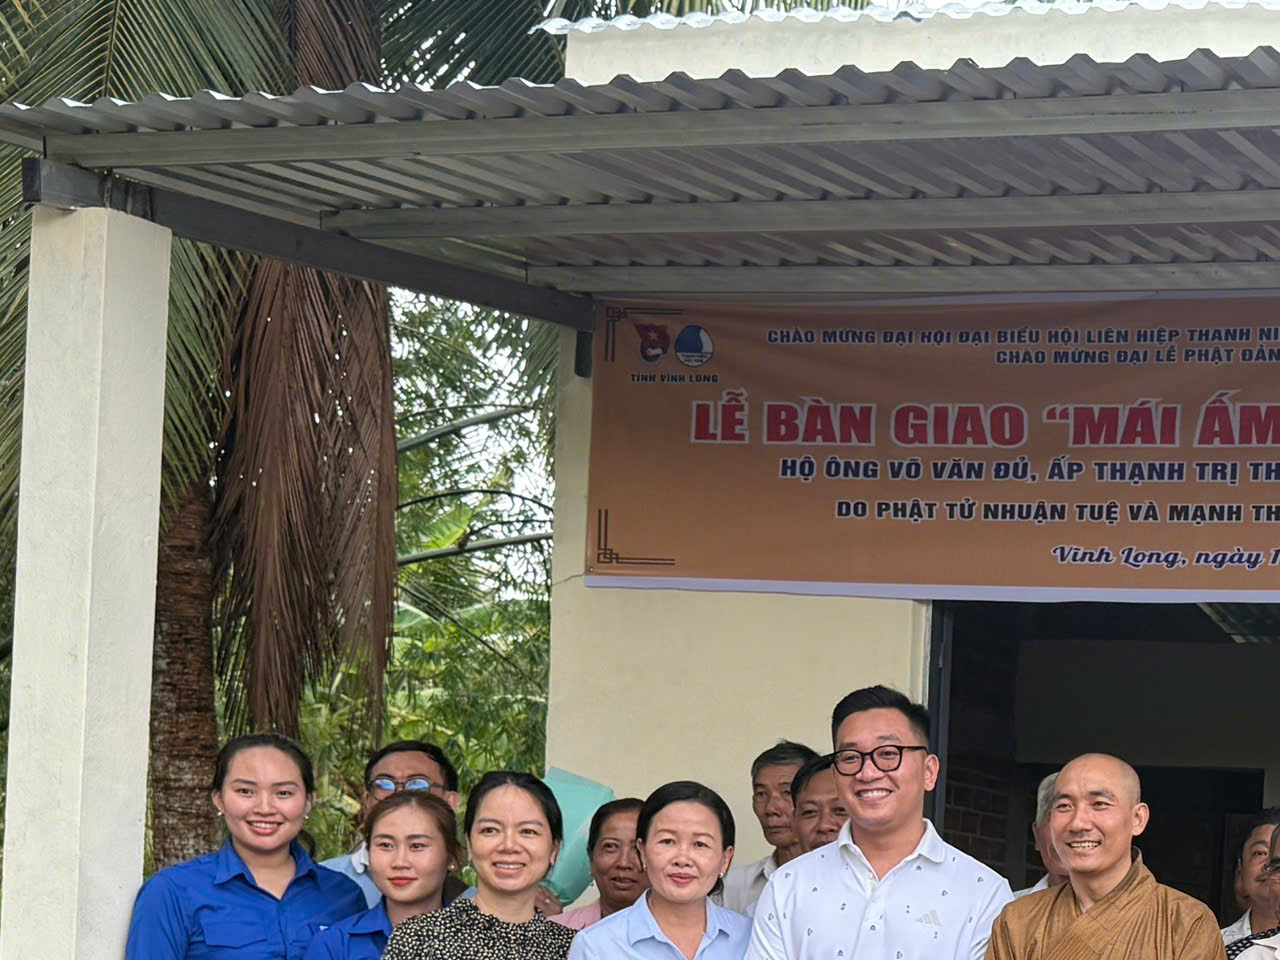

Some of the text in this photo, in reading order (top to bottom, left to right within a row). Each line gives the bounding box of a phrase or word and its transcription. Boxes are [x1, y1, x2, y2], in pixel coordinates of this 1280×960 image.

[767, 327, 815, 345] CHÀO
[882, 330, 914, 347] ĐẠI
[919, 329, 951, 347] HỘI
[957, 330, 991, 347] ĐẠI
[1047, 328, 1080, 346] HỘI
[1086, 328, 1129, 345] LIÊN
[1136, 328, 1180, 346] HIỆP
[1187, 328, 1251, 344] THANH
[995, 348, 1047, 365] CHÀO
[1053, 347, 1110, 365] MỪNG
[1116, 348, 1150, 366] ĐẠI
[1155, 344, 1178, 363] LỄ
[1183, 346, 1234, 365] PHẬT
[689, 374, 718, 382] LONG
[692, 389, 747, 442] LỄ
[765, 397, 874, 444] BÀN
[893, 405, 1025, 446] GIAO
[1044, 399, 1179, 446] “MÁI
[781, 457, 815, 481] HỘ
[825, 457, 879, 479] ÔNG
[889, 458, 922, 480] VÕ
[931, 458, 984, 480] VĂN
[993, 457, 1037, 482] ĐỦ,
[1047, 455, 1083, 480] ẤP
[1094, 462, 1184, 484] THẠNH
[1195, 462, 1239, 484] TRỊ
[837, 501, 868, 518] DO
[876, 500, 937, 522] PHẬT
[945, 498, 976, 520] TỬ
[983, 501, 1066, 524] NHUẬN
[1075, 502, 1119, 525] TUỆ
[1128, 502, 1160, 521] VÀ
[1169, 503, 1243, 525] MẠNH
[1053, 547, 1114, 564] Vĩnh
[1120, 547, 1188, 569] Long,
[1196, 548, 1263, 569] ngày
